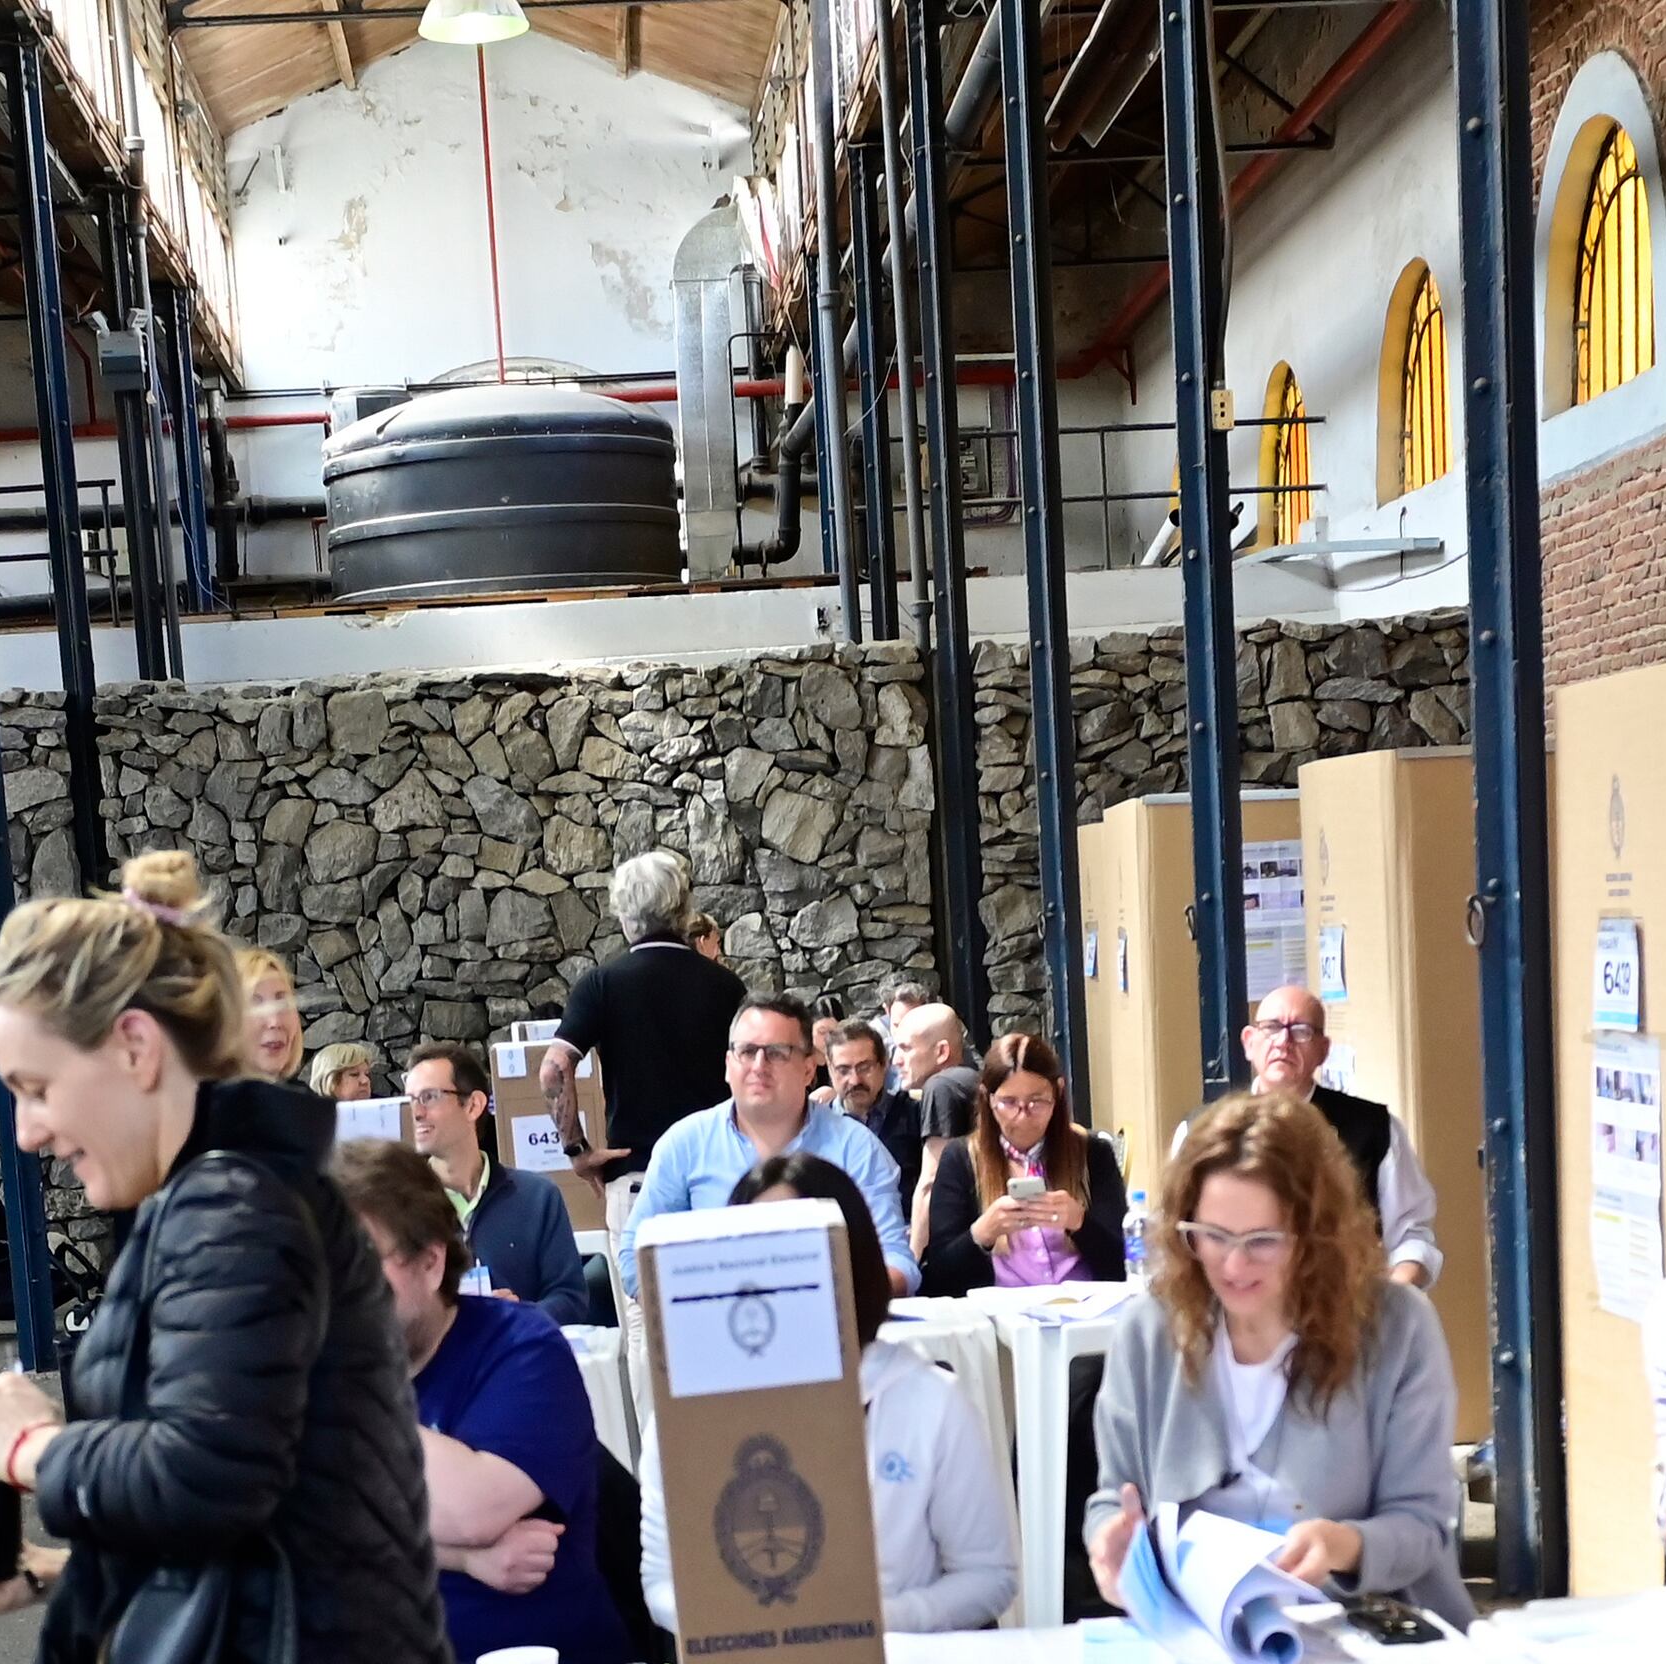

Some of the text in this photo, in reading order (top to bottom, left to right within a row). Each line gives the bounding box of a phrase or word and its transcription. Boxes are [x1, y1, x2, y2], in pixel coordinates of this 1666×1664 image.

[528, 1131, 561, 1146] 643
[686, 1620, 875, 1655] ELECCIONES ARGENTINAS
